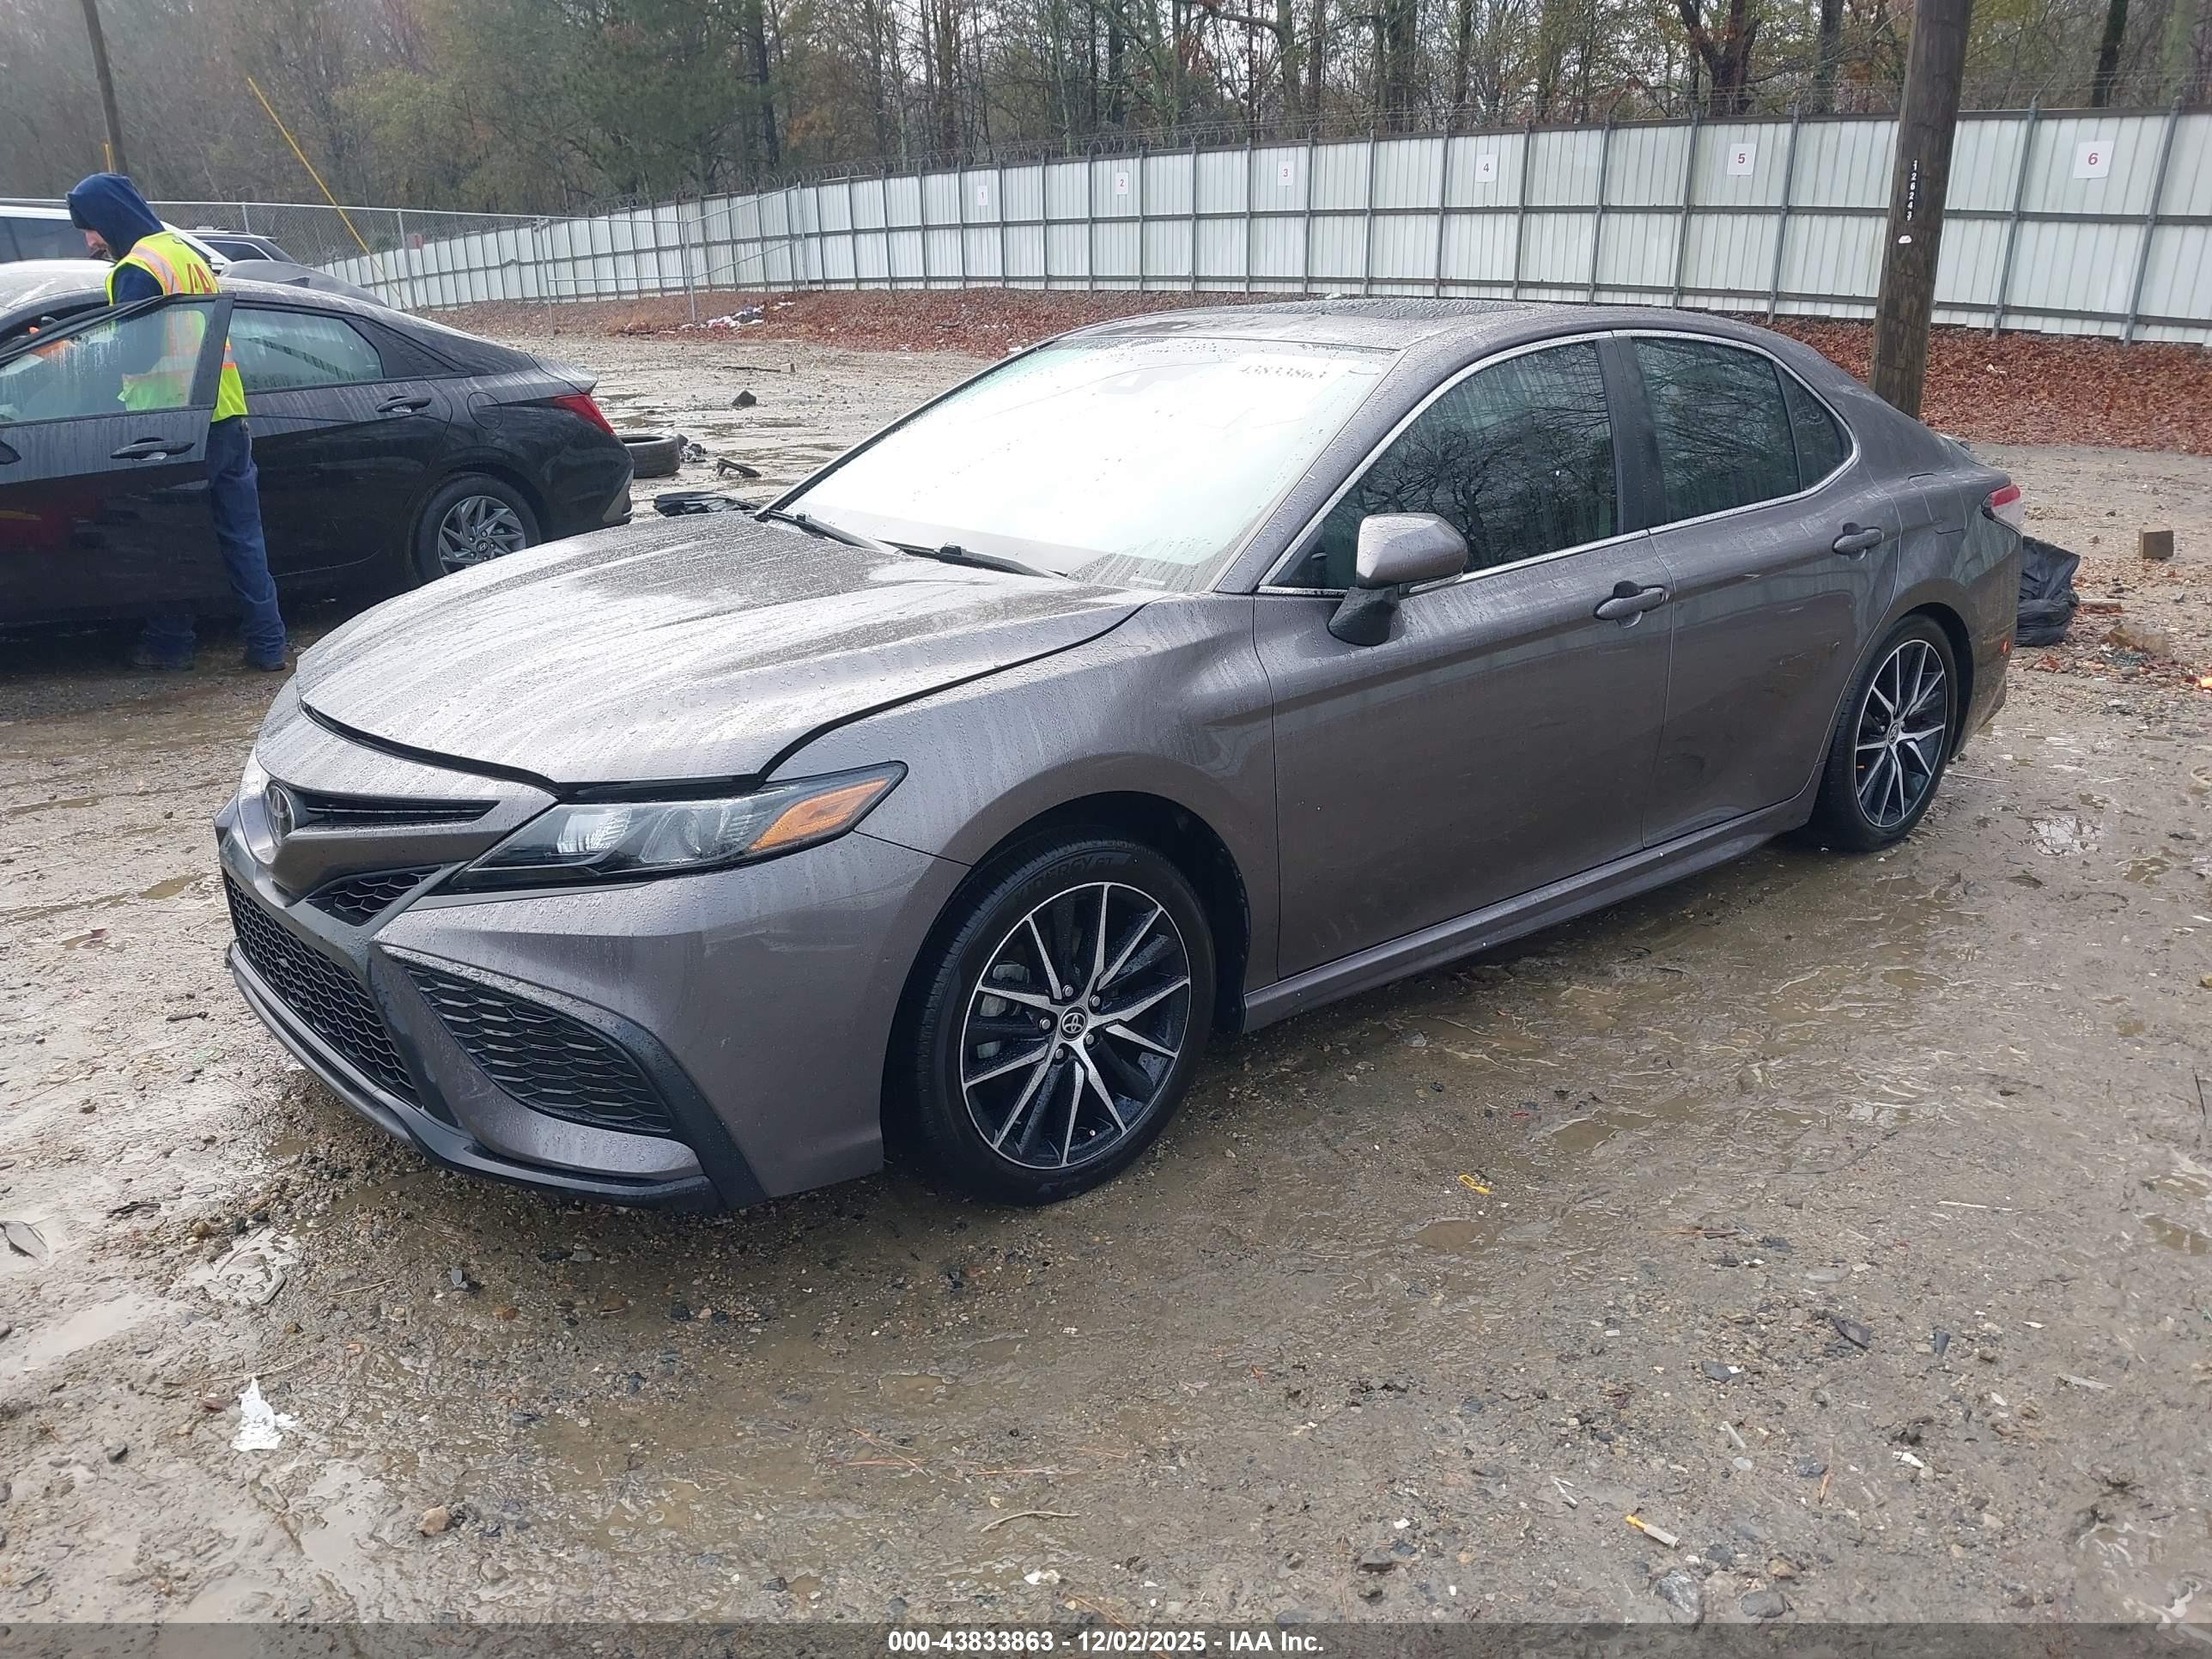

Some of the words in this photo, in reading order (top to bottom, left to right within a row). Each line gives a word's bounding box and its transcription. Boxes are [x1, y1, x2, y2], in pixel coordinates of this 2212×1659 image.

[1737, 153, 1746, 164] 5
[2088, 152, 2099, 165] 6
[1283, 168, 1289, 177] 3
[1483, 163, 1490, 172] 4
[1120, 179, 1125, 187] 2
[1907, 159, 1918, 221] 126243
